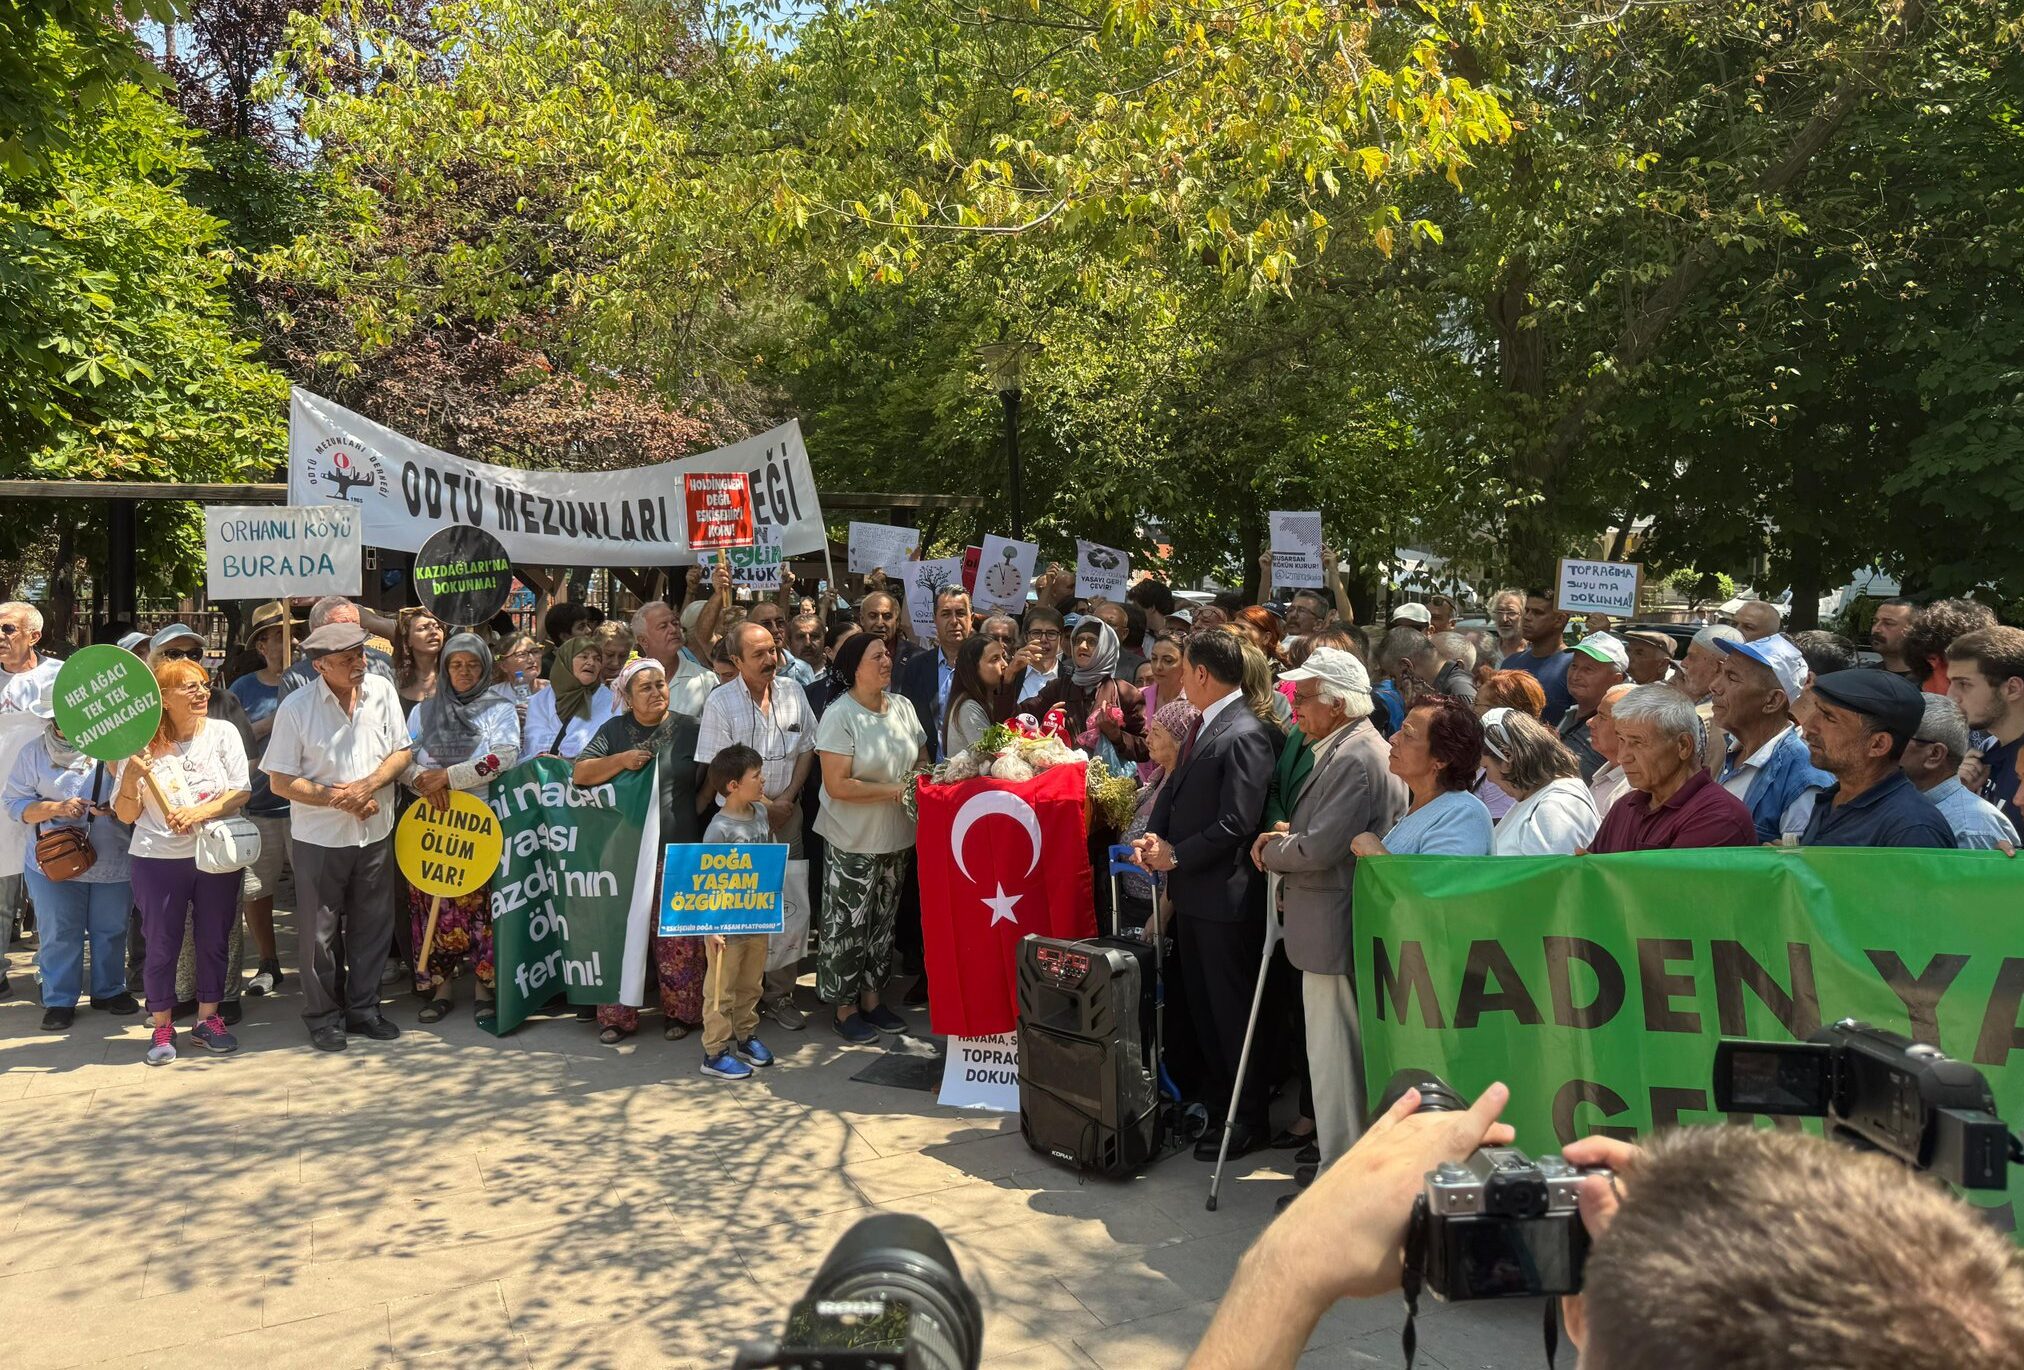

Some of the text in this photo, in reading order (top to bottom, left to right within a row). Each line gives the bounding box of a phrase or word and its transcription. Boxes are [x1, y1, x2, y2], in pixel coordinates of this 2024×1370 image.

[402, 460, 483, 527] ODTÜ
[495, 484, 672, 543] MEZUNLARI
[706, 491, 731, 506] DEĞİL
[221, 517, 351, 542] ORHANLI KÖYÜ
[708, 524, 735, 537] KORU!
[223, 553, 335, 577] BURADA
[416, 559, 509, 580] KAZDAĞLARI'NA
[433, 576, 497, 595] DOKUNMA!
[1570, 591, 1633, 608] DOKUNMA!
[64, 662, 128, 708] HER AĞACI
[82, 685, 130, 720] TEK TEK
[75, 691, 158, 749] SAVUNACAĞIZ
[414, 803, 492, 835] ALTINDA
[421, 828, 474, 860] ÖLÜM
[700, 848, 753, 870] DOĞA
[422, 860, 465, 887] VAR!
[692, 873, 759, 893] YAŞAM
[671, 890, 775, 911] ÖZGÜRLÜK!
[697, 923, 713, 931] DOĞA
[1373, 935, 1822, 1041] MADEN
